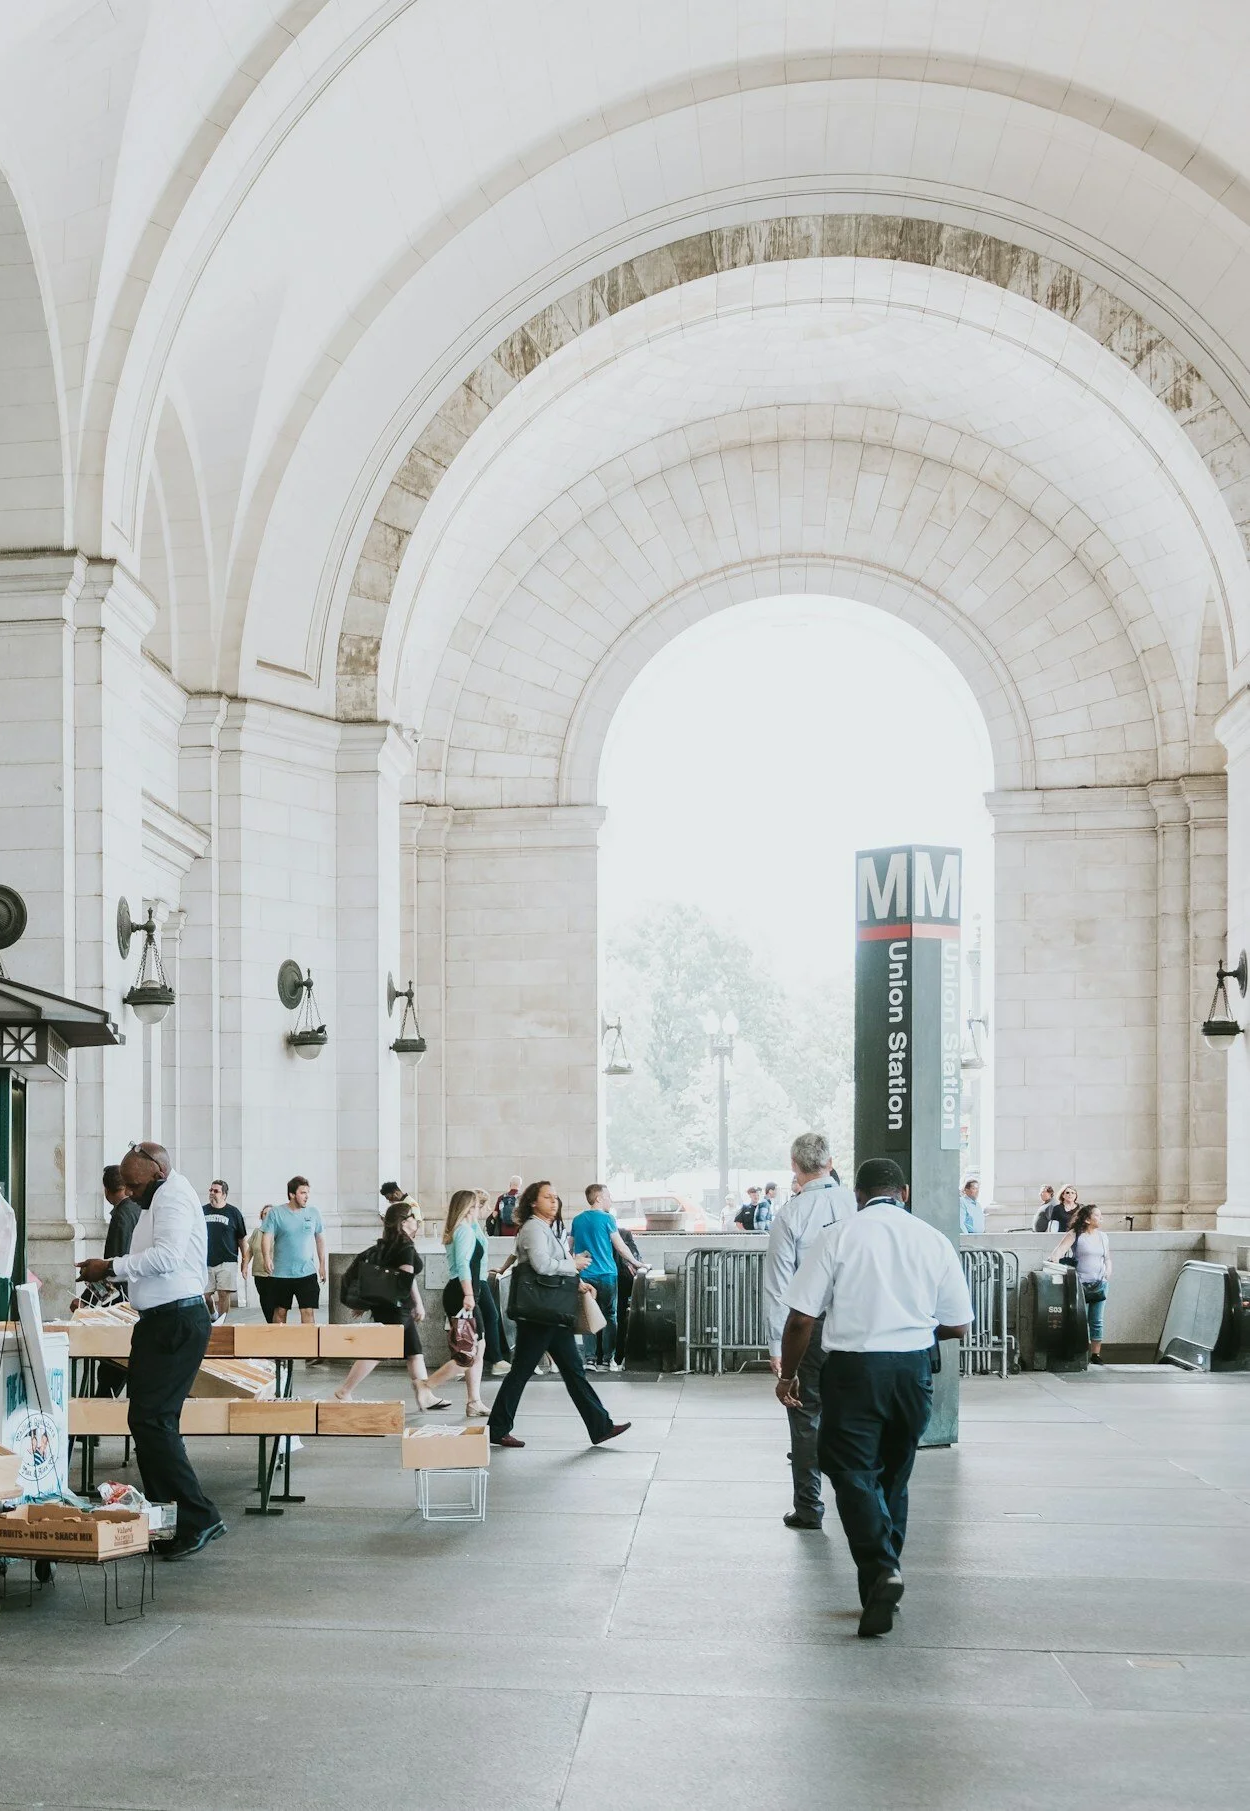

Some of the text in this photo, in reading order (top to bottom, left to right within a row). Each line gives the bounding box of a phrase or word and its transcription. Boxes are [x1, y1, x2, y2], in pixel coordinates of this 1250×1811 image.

[857, 851, 908, 921] M
[914, 850, 960, 919] M
[889, 940, 908, 1130] Union Station
[942, 941, 959, 1130] Union Station
[0, 1529, 23, 1538] FRUITS
[29, 1531, 48, 1539] NUTS
[54, 1532, 78, 1541] SNACK
[79, 1533, 93, 1541] MIX
